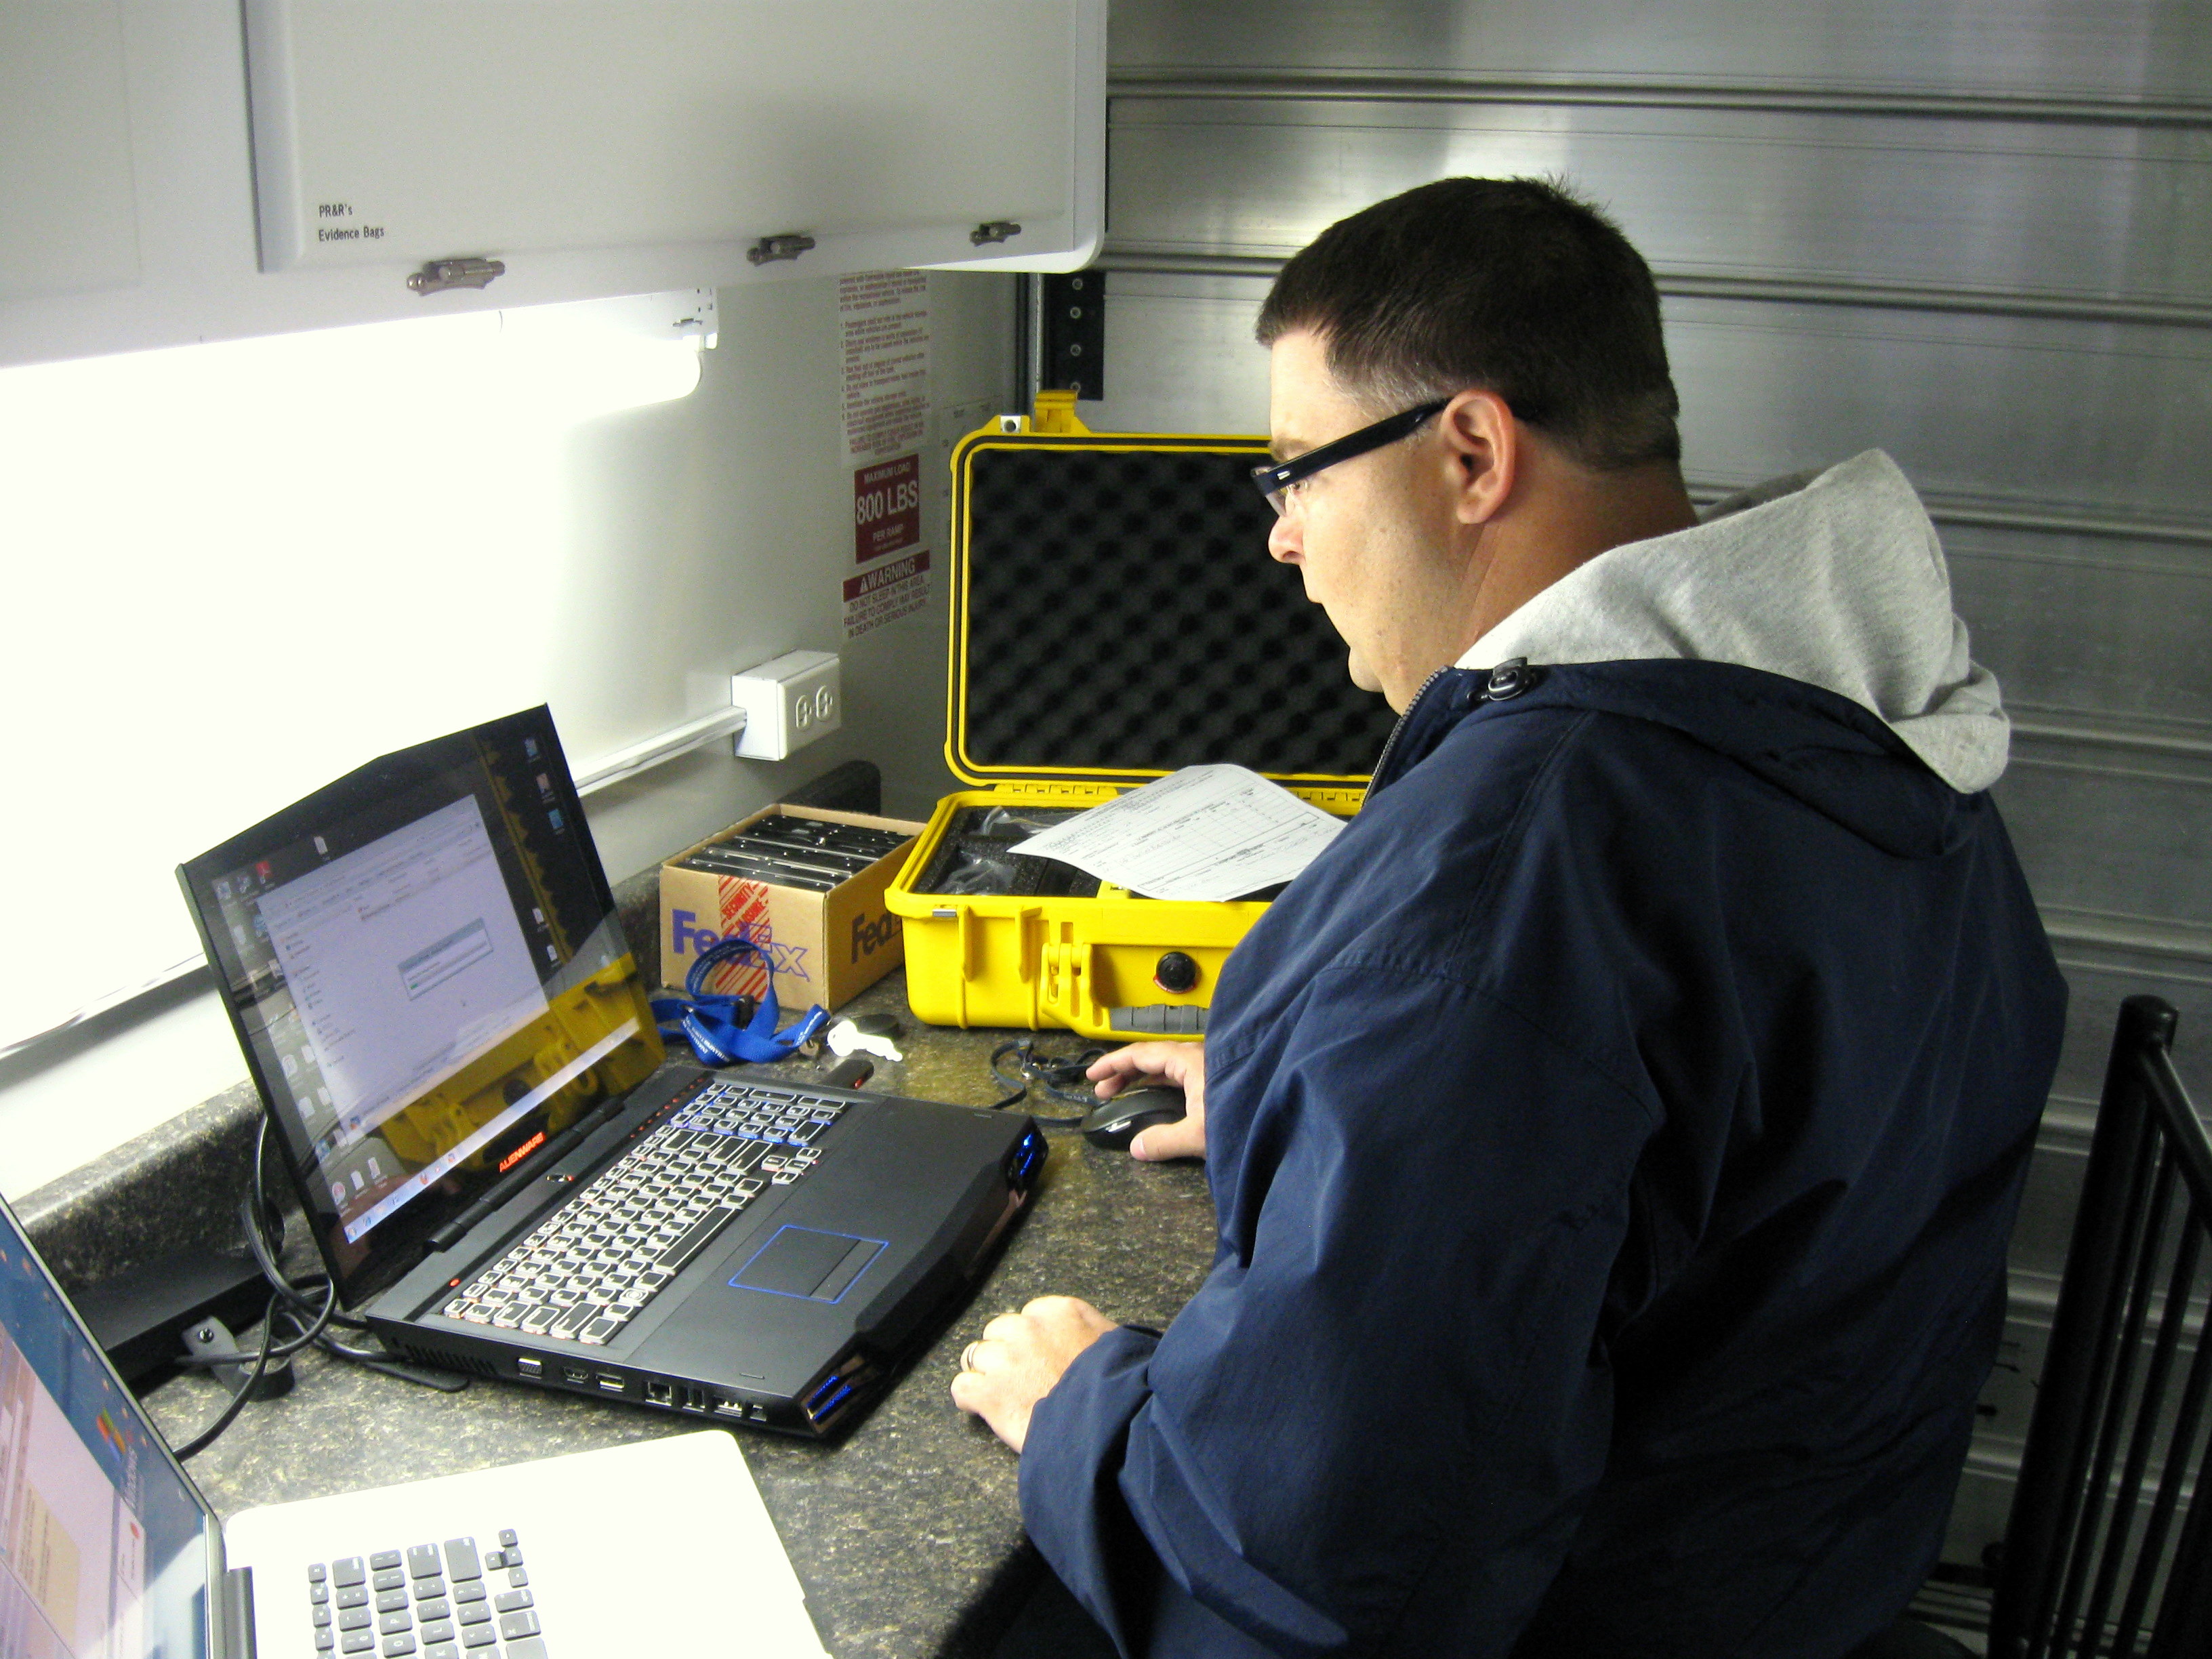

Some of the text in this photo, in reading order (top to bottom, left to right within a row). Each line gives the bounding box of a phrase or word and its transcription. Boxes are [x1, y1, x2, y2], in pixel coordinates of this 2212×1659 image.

[319, 203, 353, 218] PR&R's
[319, 226, 385, 242] Evidence Bags
[857, 480, 918, 525] 800 LBS
[867, 558, 916, 588] WARNING
[672, 909, 811, 982] FedEx
[499, 1131, 546, 1173] ALIENWARE
